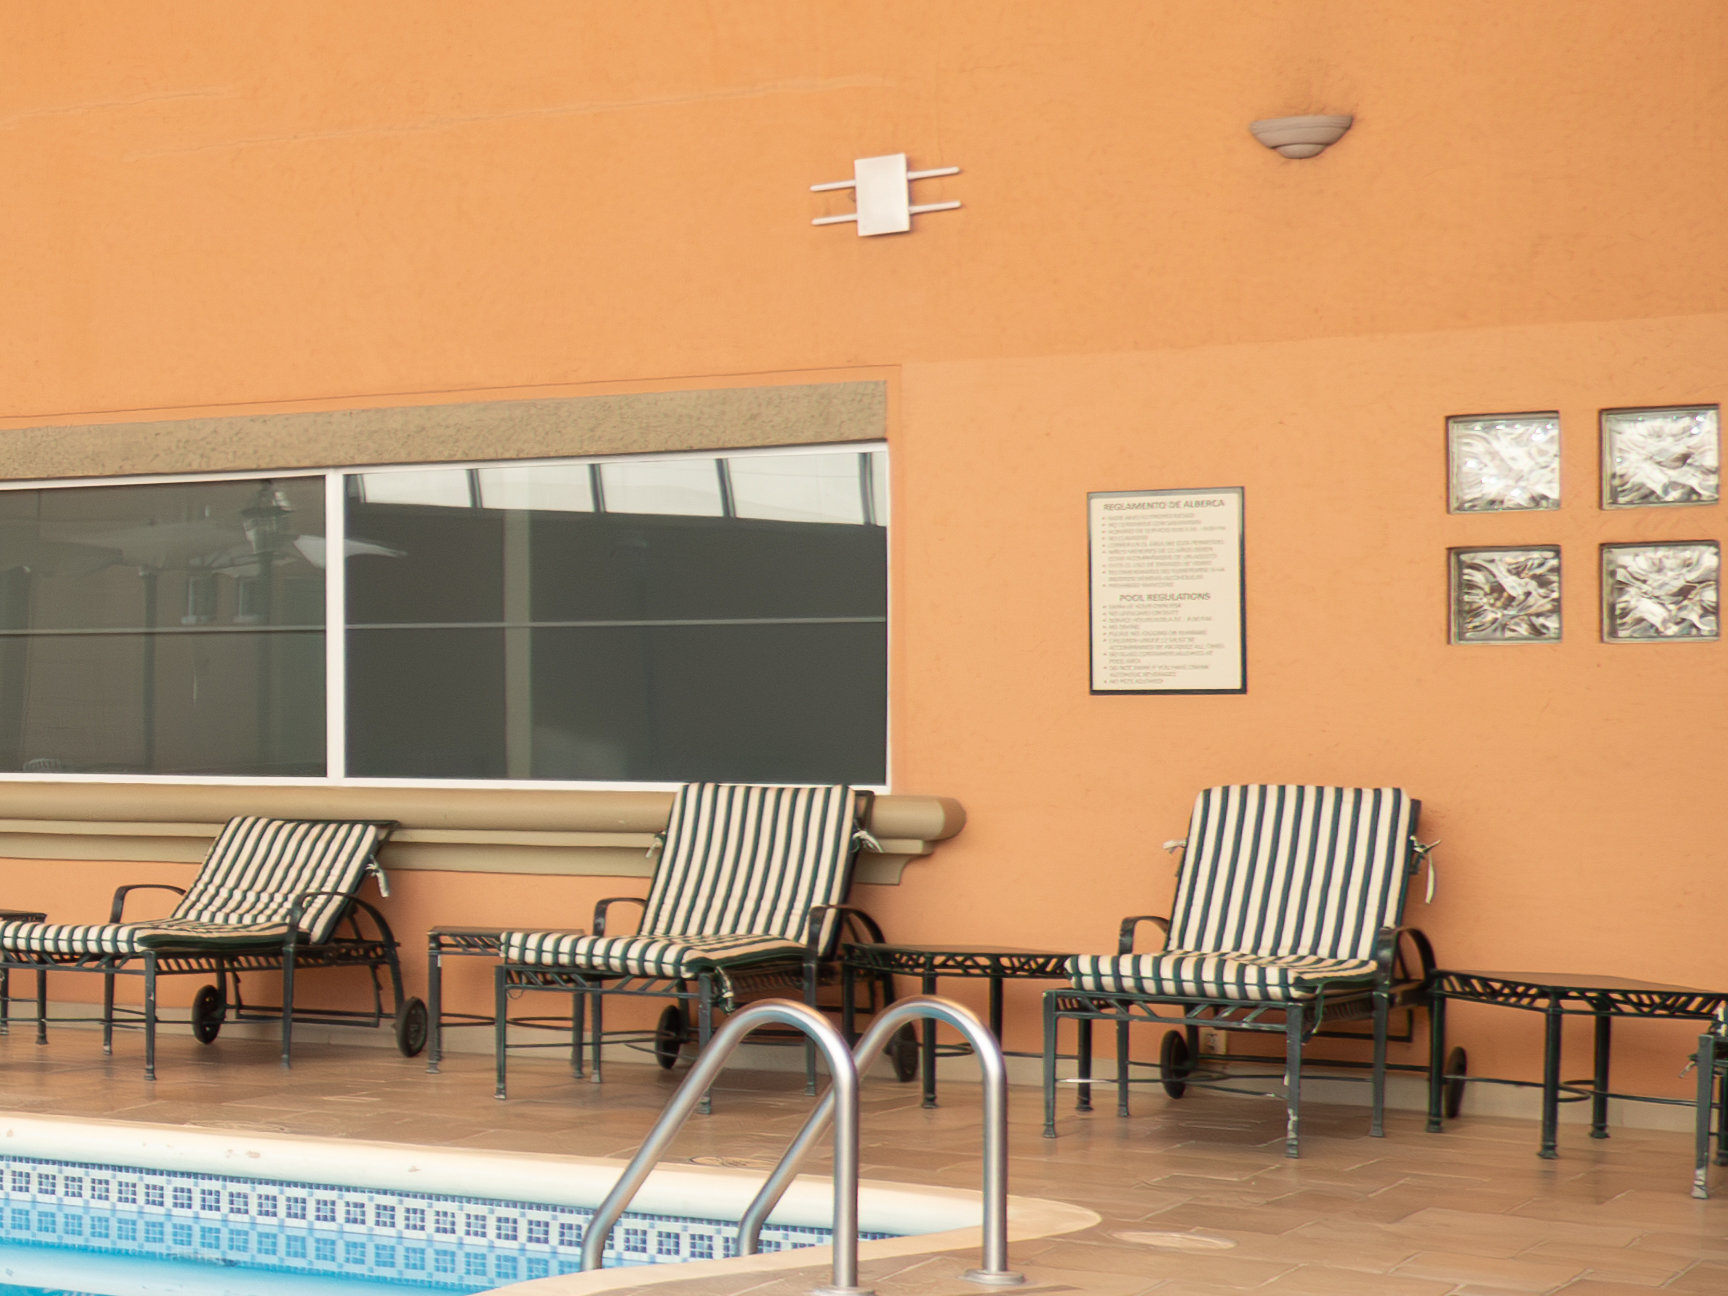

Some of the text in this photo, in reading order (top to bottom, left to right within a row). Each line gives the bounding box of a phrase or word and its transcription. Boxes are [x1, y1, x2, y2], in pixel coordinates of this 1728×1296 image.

[1169, 500, 1181, 509] DE
[1184, 499, 1225, 508] ALBERCA
[1147, 592, 1211, 602] REGULATIONS
